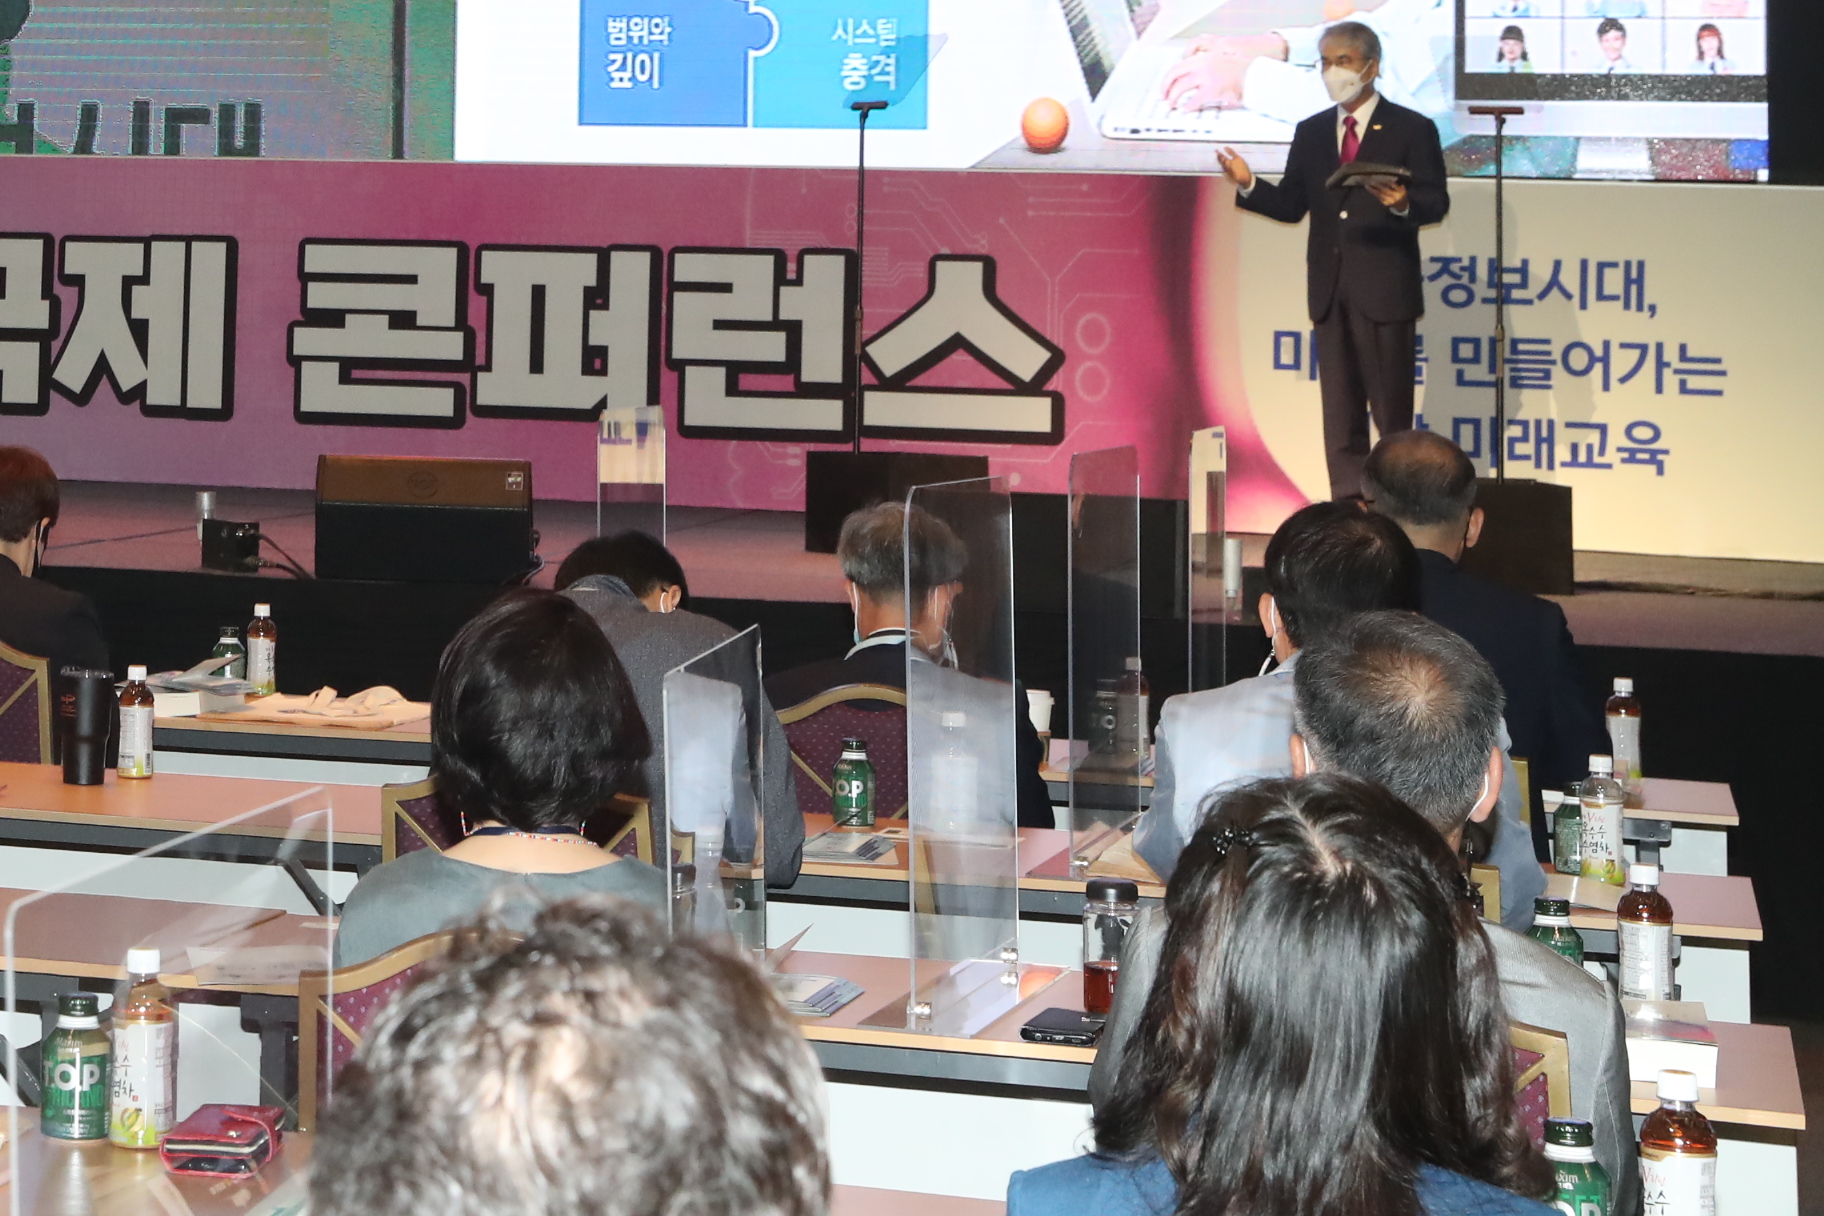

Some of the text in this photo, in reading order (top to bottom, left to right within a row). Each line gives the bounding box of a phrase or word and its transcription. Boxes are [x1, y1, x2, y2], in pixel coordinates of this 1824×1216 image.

[606, 15, 674, 46] 범위와
[830, 17, 898, 46] 시스템
[606, 51, 662, 90] 깊이
[840, 52, 897, 91] 충격
[1426, 255, 1658, 319] 정보시대,
[288, 239, 1066, 447] 콘퍼런스
[1451, 336, 1728, 397] 만들어가는
[1452, 417, 1671, 477] 미래교육
[1555, 1170, 1579, 1184] xim
[1644, 1190, 1672, 1216] 수수
